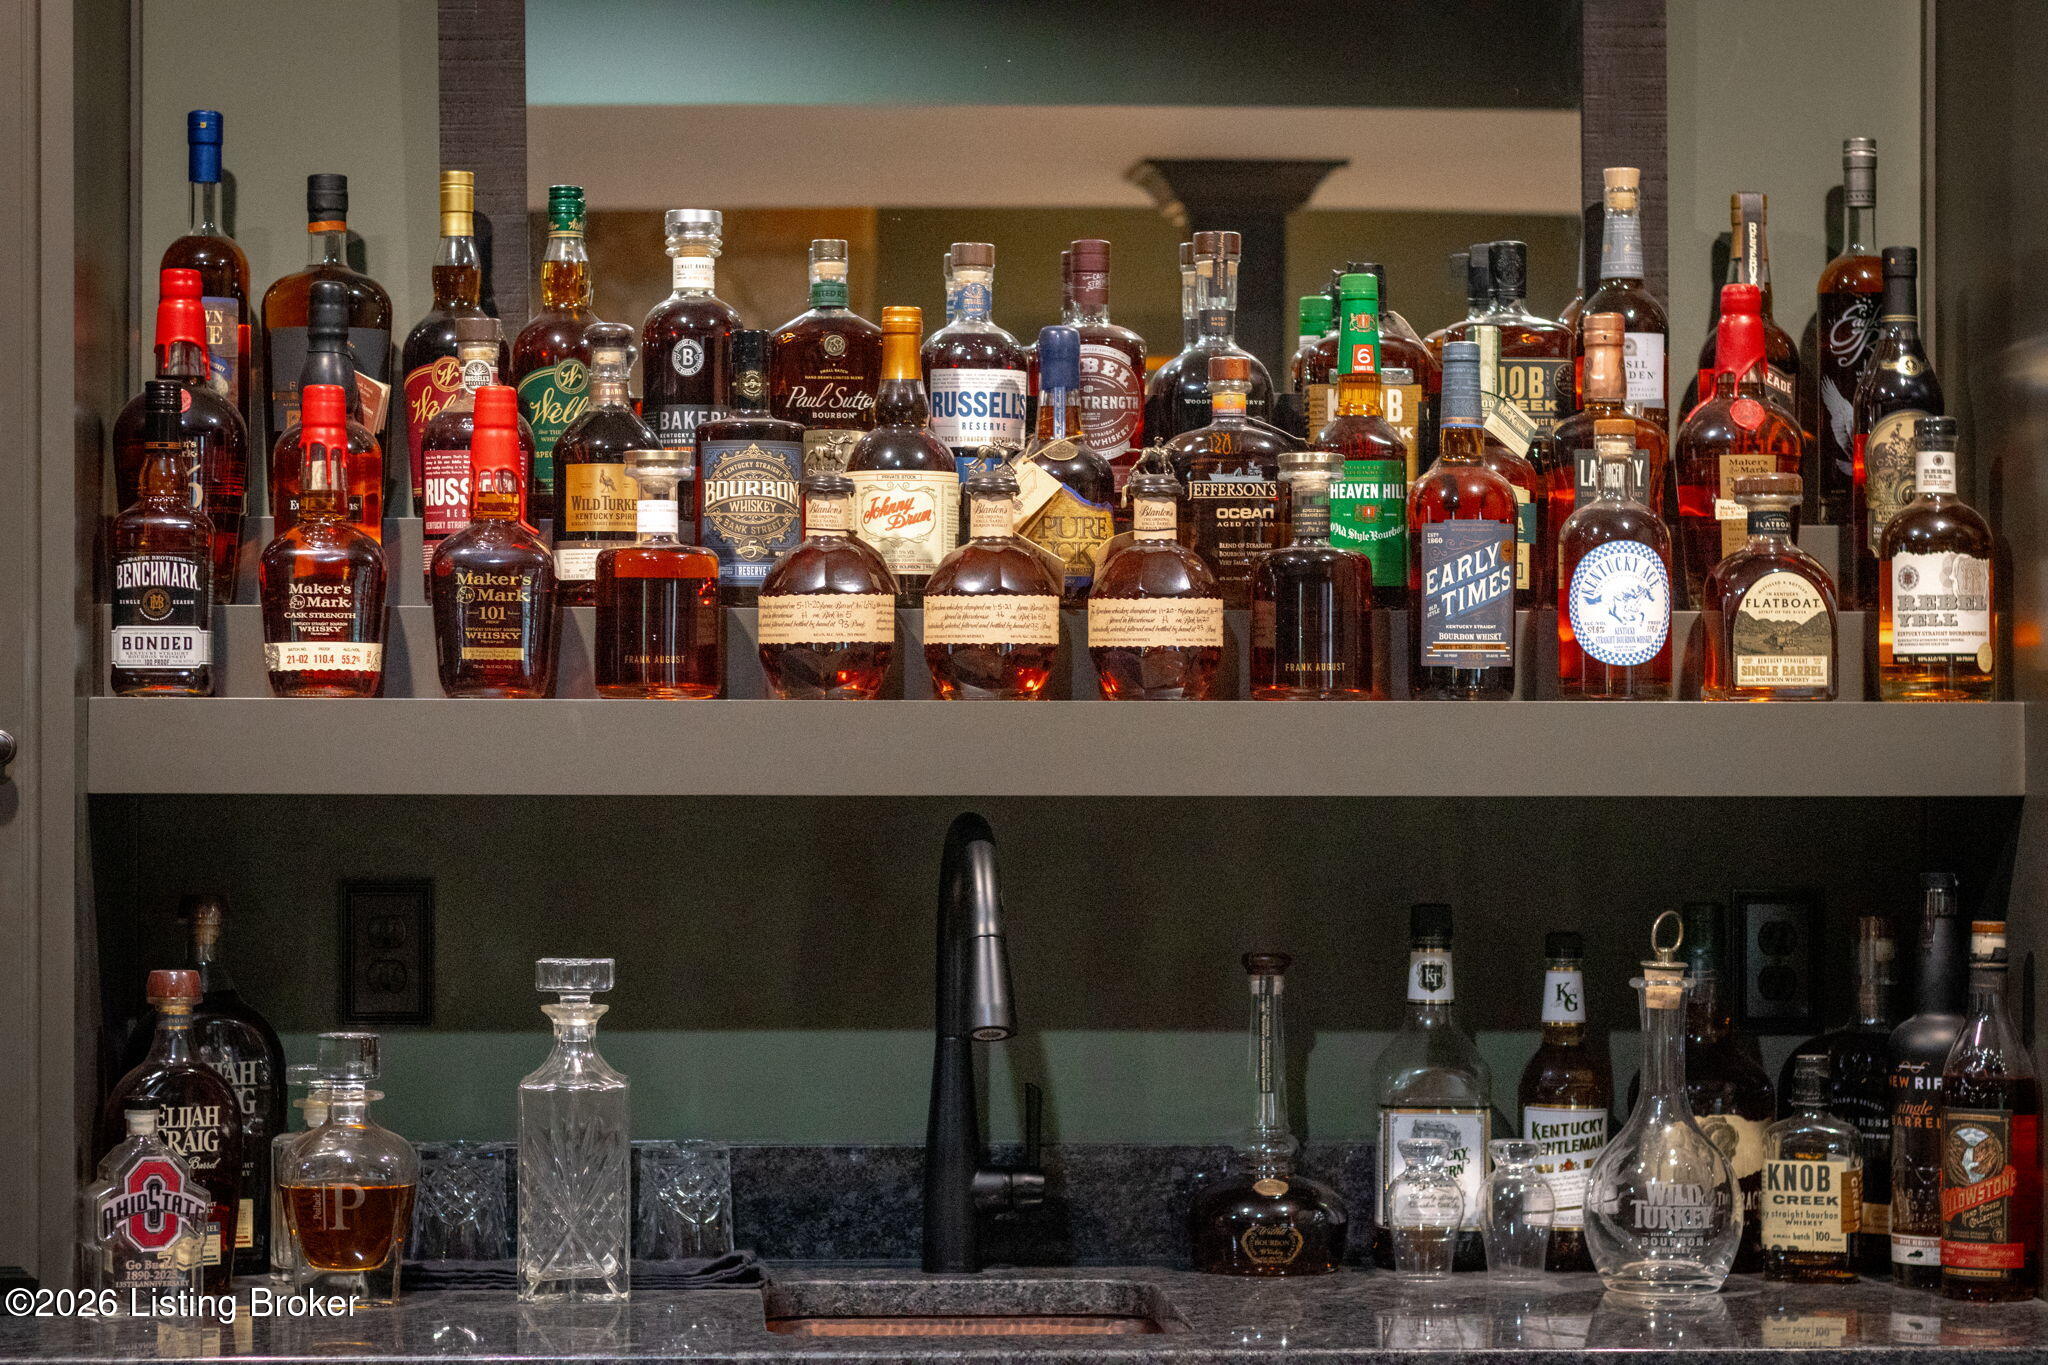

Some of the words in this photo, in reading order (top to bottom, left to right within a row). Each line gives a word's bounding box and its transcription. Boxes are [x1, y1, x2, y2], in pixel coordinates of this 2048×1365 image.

[682, 348, 694, 366] B
[1357, 348, 1371, 364] 6
[1083, 357, 1131, 388] BEL
[785, 382, 833, 408] Paul
[529, 387, 590, 425] Well
[932, 391, 1025, 420] RUSSELL'S
[1515, 400, 1558, 411] EEK
[961, 422, 1007, 431] RESERVE
[1090, 425, 1130, 448] WHISKEY
[722, 461, 754, 476] KENTUCKY
[755, 461, 783, 476] STRAIGHT
[1728, 458, 1768, 466] Maker's
[704, 480, 801, 508] BOURBON
[1187, 482, 1277, 500] JEFFERSON'S
[1330, 484, 1378, 499] HEAVEN
[1383, 484, 1406, 500] HILL
[570, 495, 600, 511] WILD
[601, 495, 637, 512] TURKE
[729, 500, 777, 513] WHISKEY
[808, 503, 842, 515] Blanton's
[863, 496, 915, 525] Johnny
[974, 503, 1008, 515] Blanton's
[575, 512, 614, 520] KENTUCKY
[885, 509, 932, 531] Drum
[723, 519, 748, 534] BANK
[750, 520, 782, 536] STREET
[1037, 516, 1107, 540] PURE
[1330, 522, 1347, 538] Old
[1348, 527, 1369, 543] Style
[1368, 525, 1406, 542] Bourbon
[746, 539, 758, 558] 5
[116, 561, 201, 590] BENCHMARK
[738, 566, 767, 576] RESERVE
[1425, 541, 1500, 596] EARLY
[1581, 555, 1641, 596] KENTUCKY
[1642, 564, 1660, 590] ACE
[456, 572, 532, 586] Maker's
[288, 583, 352, 594] Maker's
[476, 588, 531, 602] Mark
[1441, 565, 1511, 617] TIMES
[307, 597, 352, 608] Mark
[1745, 598, 1820, 608] FLATBOAT
[1897, 594, 1987, 611] REBEL
[479, 607, 507, 620] 101
[1898, 614, 1958, 627] YELL
[122, 637, 192, 650] BONDED
[465, 632, 522, 640] WHISKY
[1439, 632, 1474, 640] BOURBON
[1476, 632, 1502, 640] WHISKY
[286, 654, 309, 665] 21-02
[314, 654, 334, 664] 110.4
[624, 655, 651, 664] FRANK
[654, 655, 686, 664] AUGUST
[1285, 663, 1312, 672] FRANK
[1315, 663, 1346, 672] AUGUST
[1741, 665, 1780, 676] SINGLE
[1782, 665, 1824, 676] BARREL
[1914, 1077, 1943, 1088] RIF
[1898, 1099, 1934, 1116] single
[157, 1104, 220, 1132] ELIJAH
[1531, 1118, 1604, 1141] KENTUCKY
[1539, 1135, 1604, 1156] ENTLEMAN
[1768, 1164, 1831, 1192] KNOB
[1645, 1180, 1702, 1206] WILD
[1772, 1195, 1838, 1206] CREEK
[103, 1193, 148, 1241] OHIO
[146, 1181, 206, 1236] STATE
[328, 1182, 366, 1230] P
[1630, 1200, 1714, 1232] TURKEY
[1771, 1209, 1804, 1221] straight
[1806, 1209, 1838, 1221] bourbon
[1642, 1238, 1704, 1246] BOURBON
[1815, 1232, 1830, 1242] 100
[126, 1260, 142, 1270] Go
